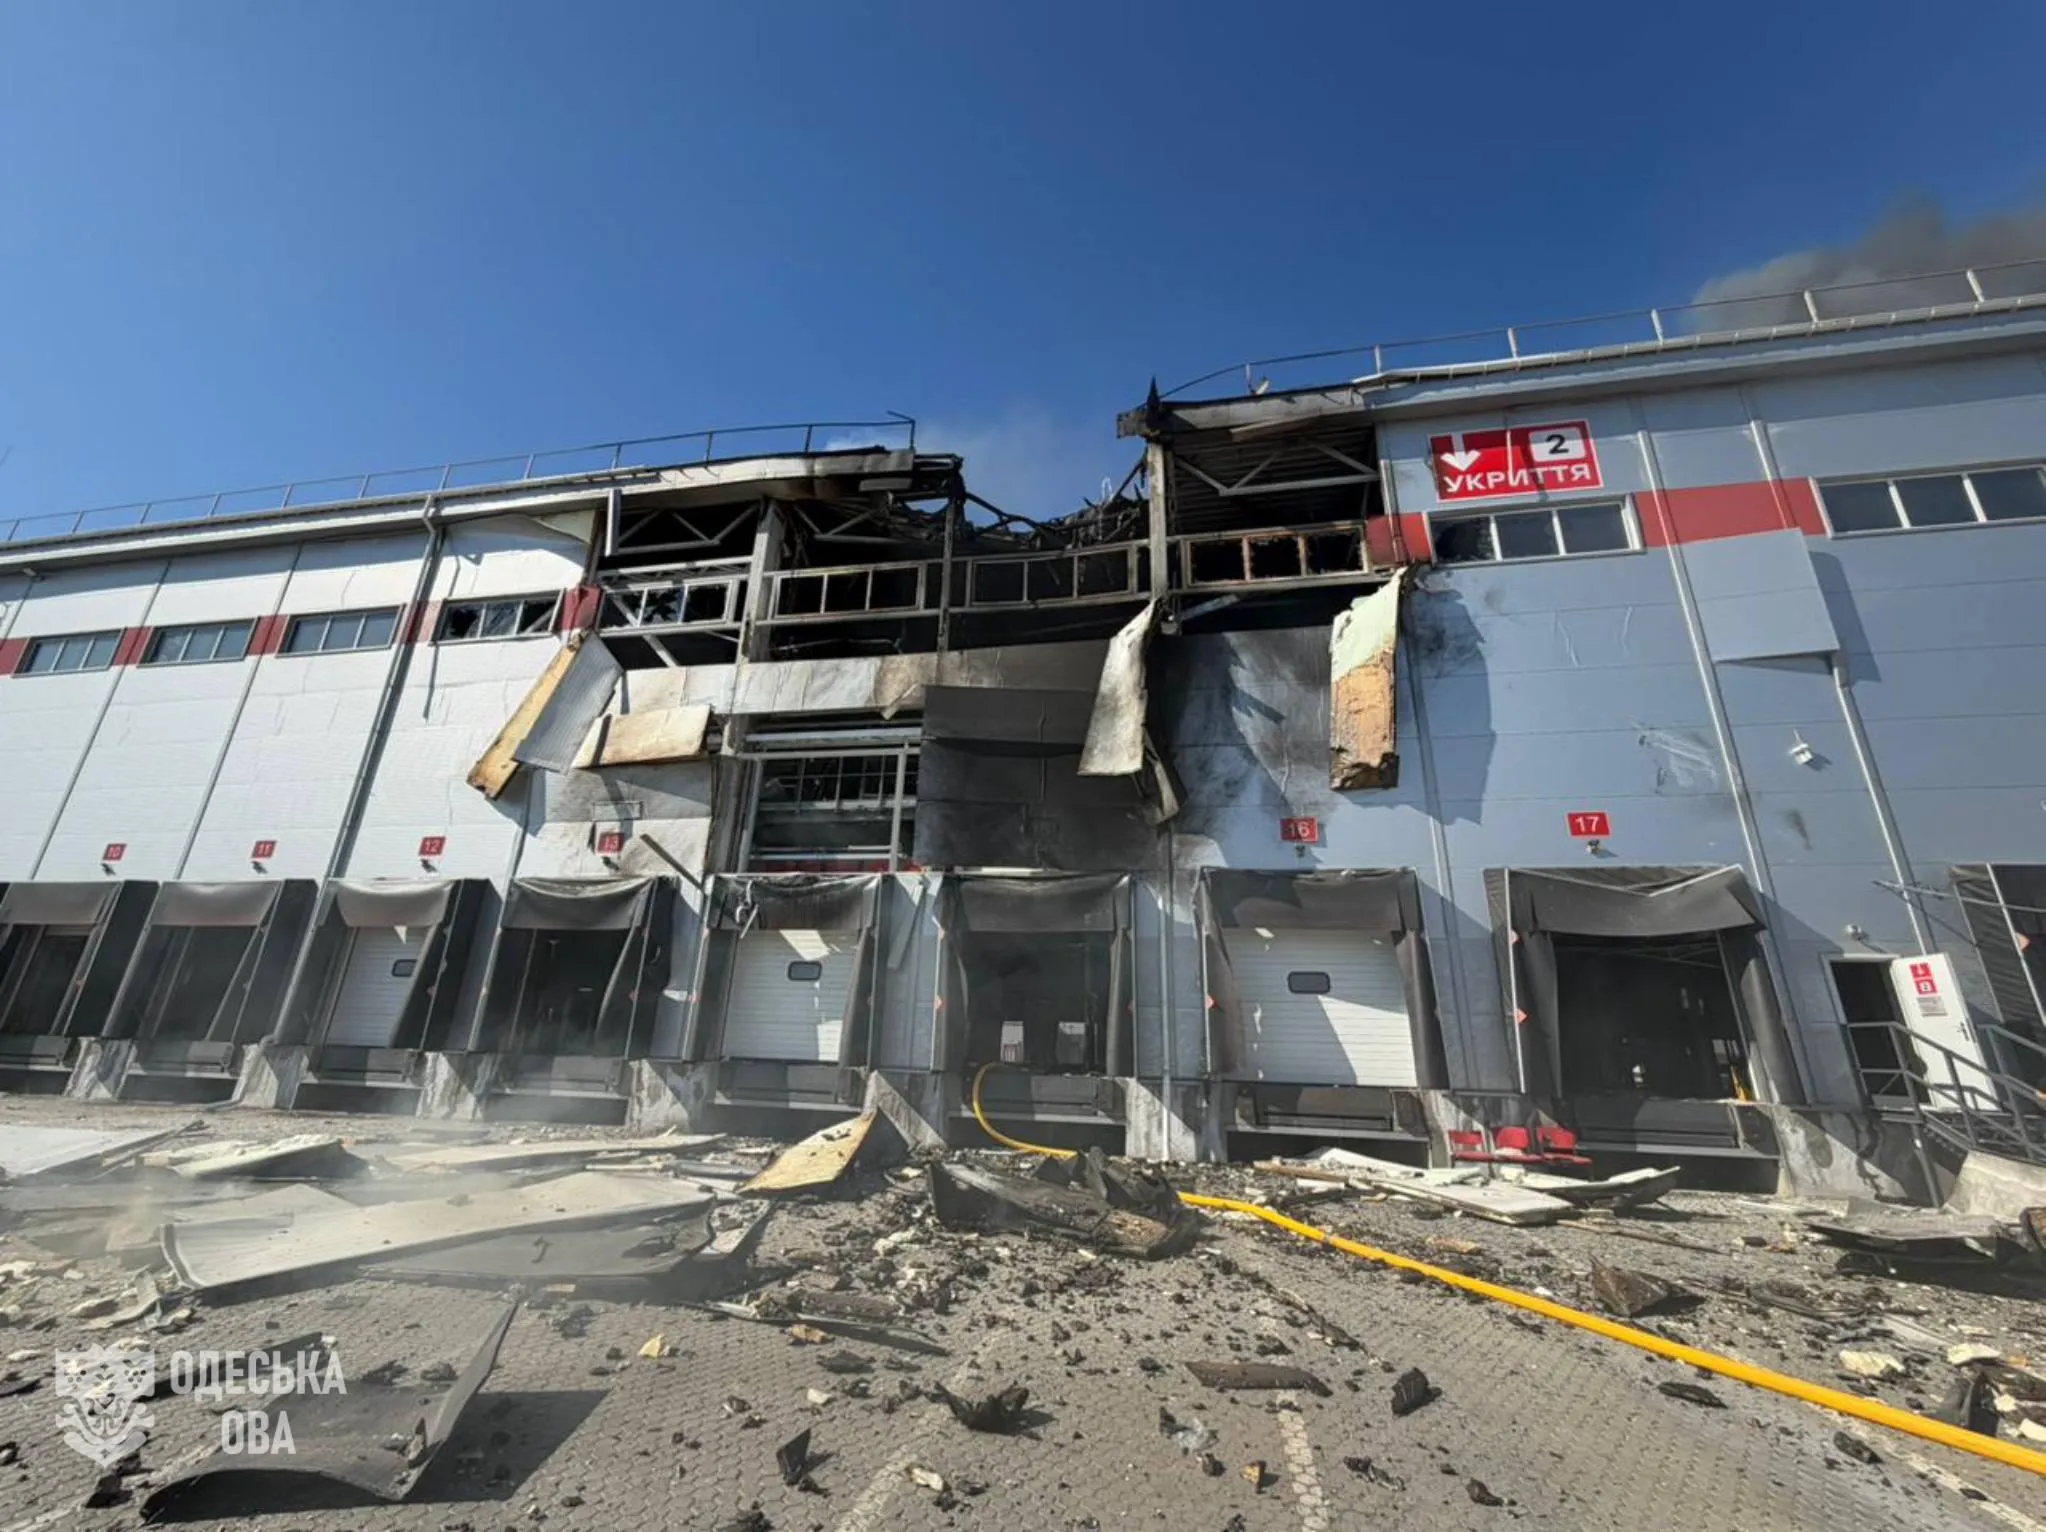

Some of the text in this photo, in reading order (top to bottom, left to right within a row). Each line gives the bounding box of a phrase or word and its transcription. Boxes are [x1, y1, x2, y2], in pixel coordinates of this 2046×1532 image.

[1546, 434, 1569, 454] 2
[1443, 463, 1592, 493] УКРИТТЯ
[1290, 821, 1310, 838] 16
[1575, 816, 1599, 832] 17
[425, 839, 440, 852] 12
